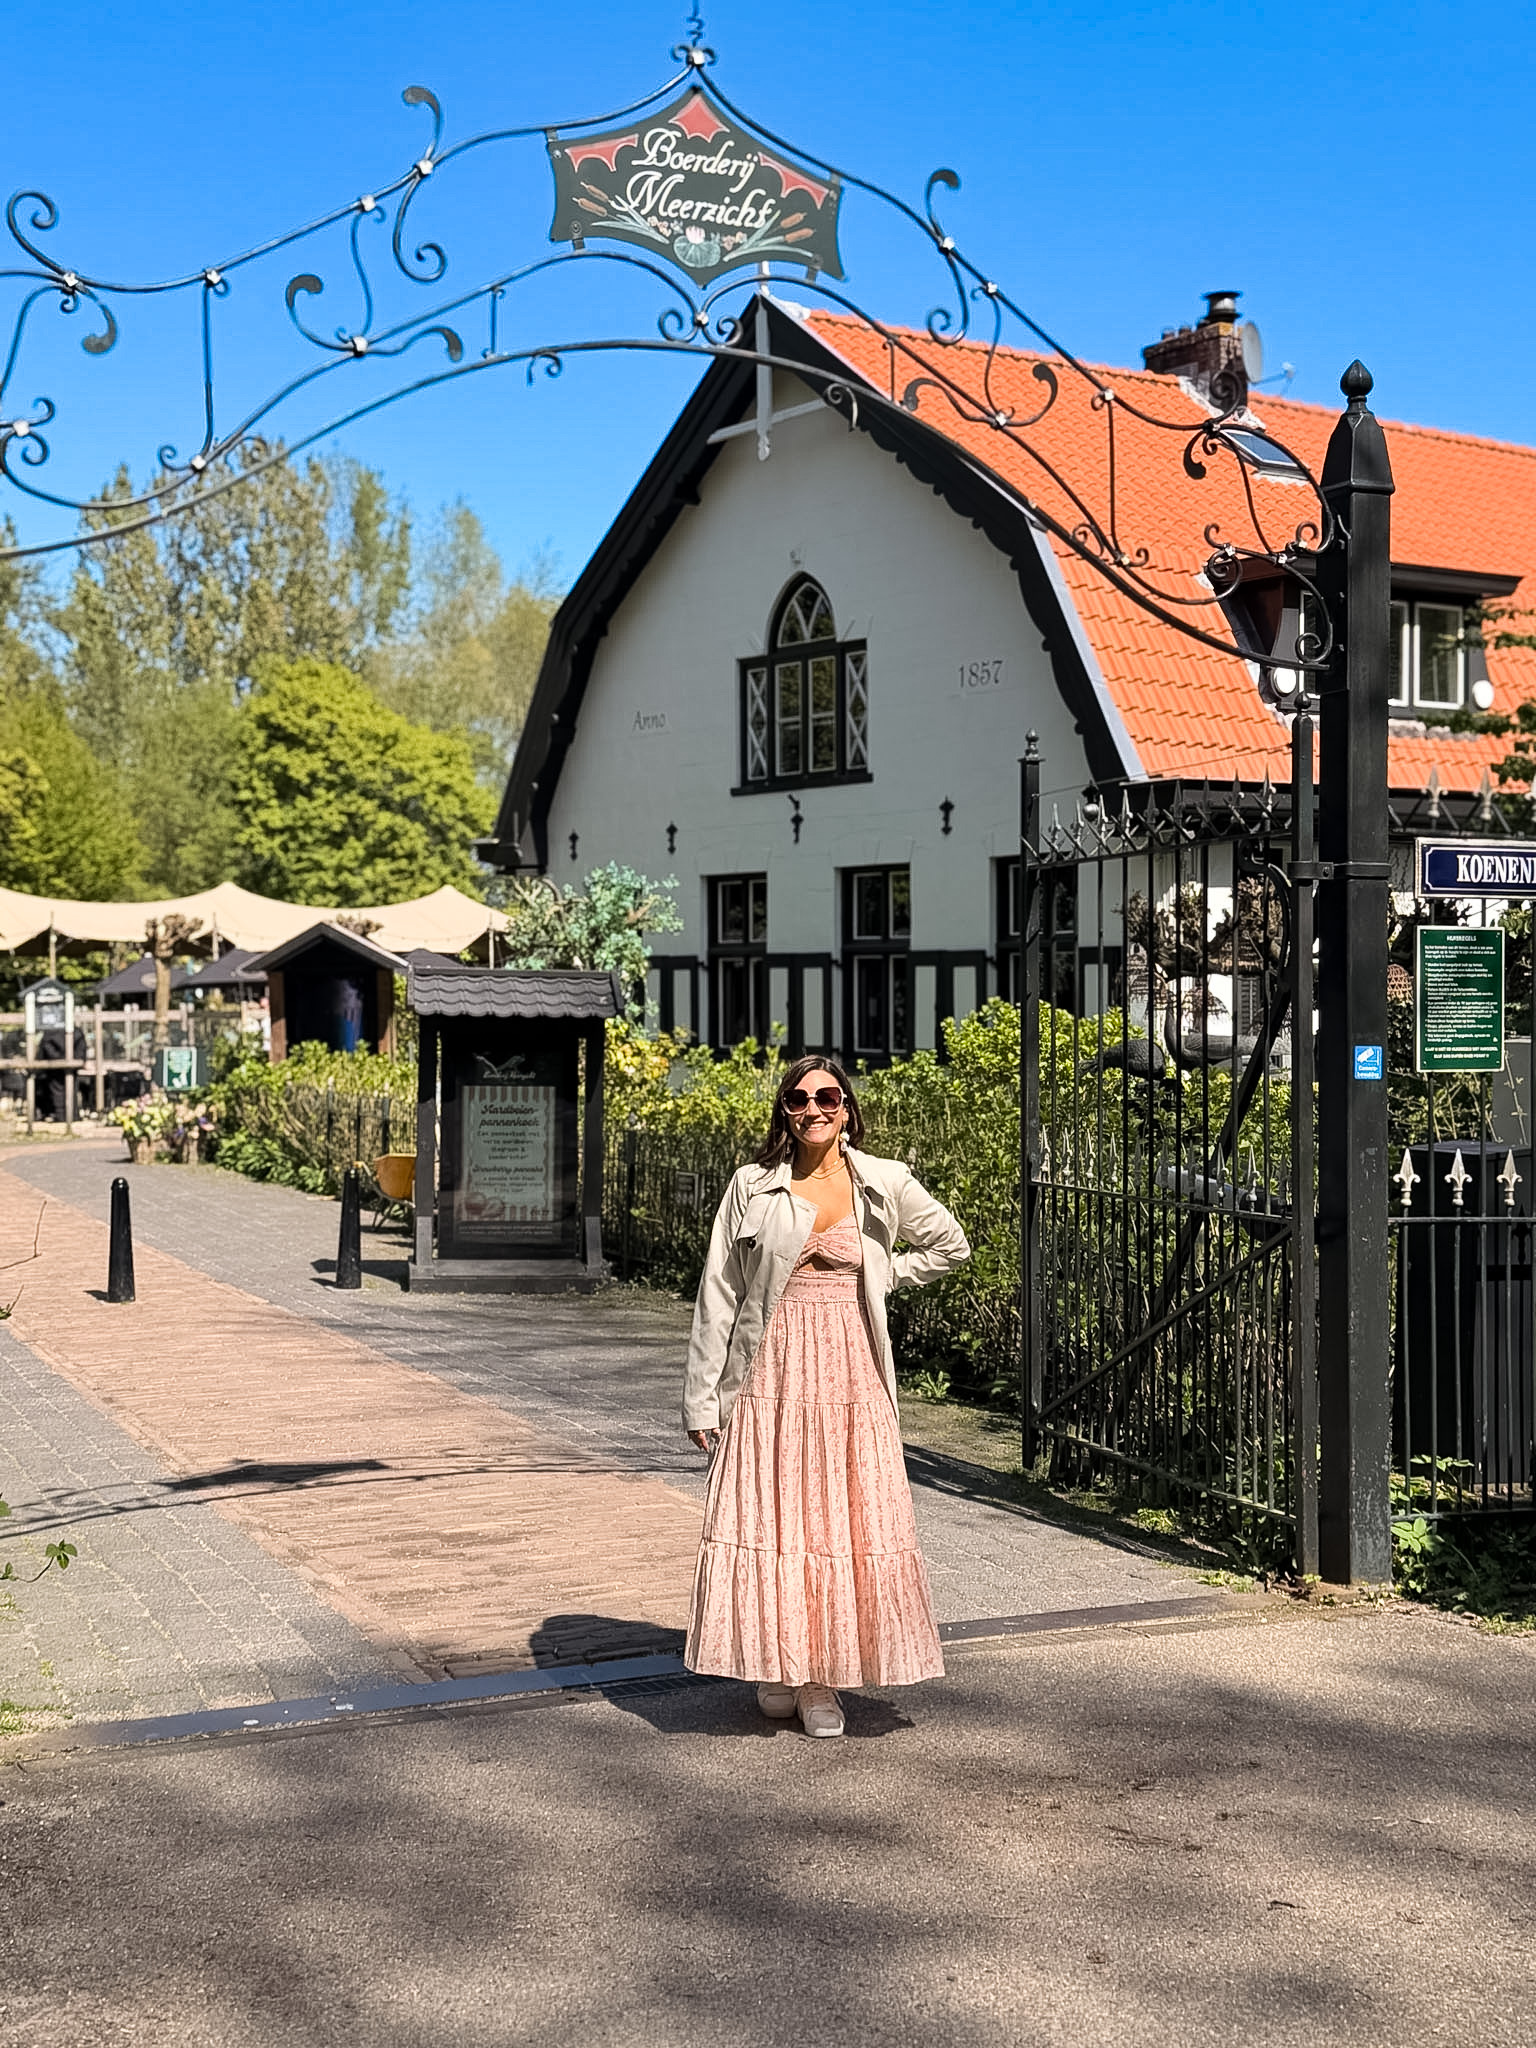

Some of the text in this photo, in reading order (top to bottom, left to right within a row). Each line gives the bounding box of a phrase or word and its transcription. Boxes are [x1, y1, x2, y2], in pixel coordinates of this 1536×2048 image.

[632, 128, 758, 193] Boerderij
[610, 170, 776, 228] Meerzicht
[959, 659, 1003, 688] 1857
[632, 709, 666, 730] Anno
[1456, 854, 1536, 884] KOENEN
